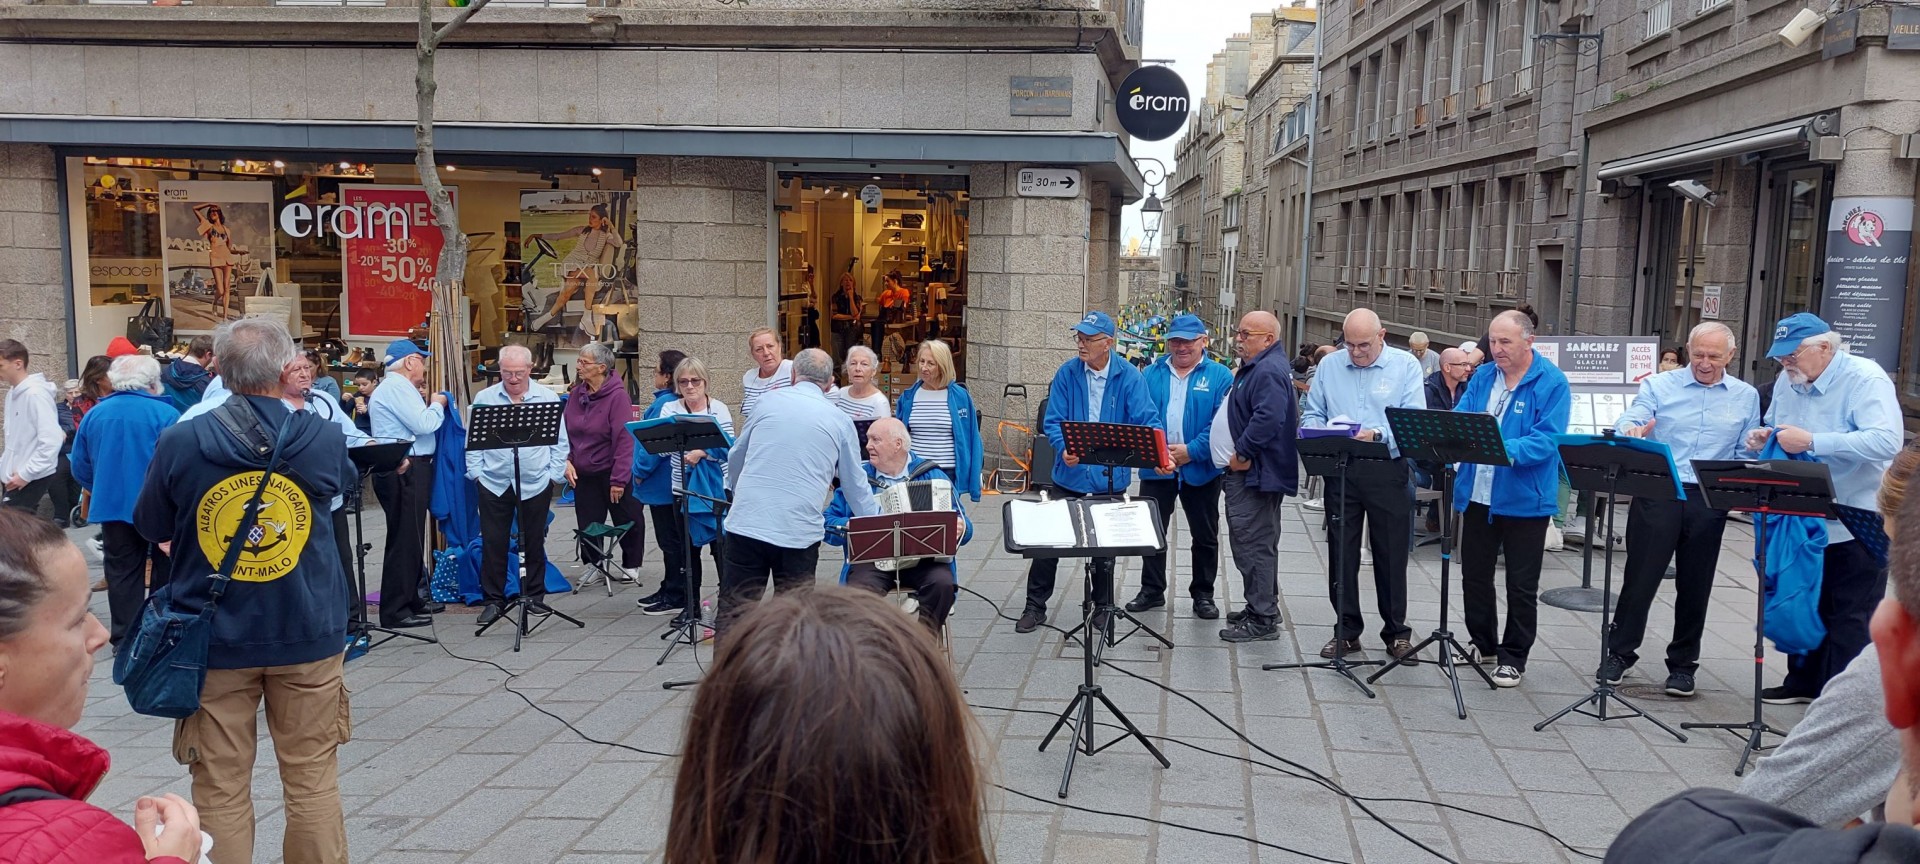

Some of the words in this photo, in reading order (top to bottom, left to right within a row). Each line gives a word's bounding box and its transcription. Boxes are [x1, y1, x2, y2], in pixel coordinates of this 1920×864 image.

[1129, 87, 1187, 112] éram
[1036, 177, 1049, 187] 30
[382, 238, 417, 254] -30%
[358, 256, 380, 267] -20%
[372, 256, 432, 283] -50%
[91, 265, 152, 279] espace
[154, 263, 163, 277] h
[550, 262, 617, 280] TEXTO
[412, 276, 436, 292] -40
[1566, 342, 1619, 352] SANCHEZ
[1632, 345, 1651, 353] ACCÈS
[200, 486, 229, 533] ALBATROS
[228, 476, 262, 492] LINES
[267, 476, 307, 531] NAVIGATION
[217, 557, 292, 577] INT-MALO
